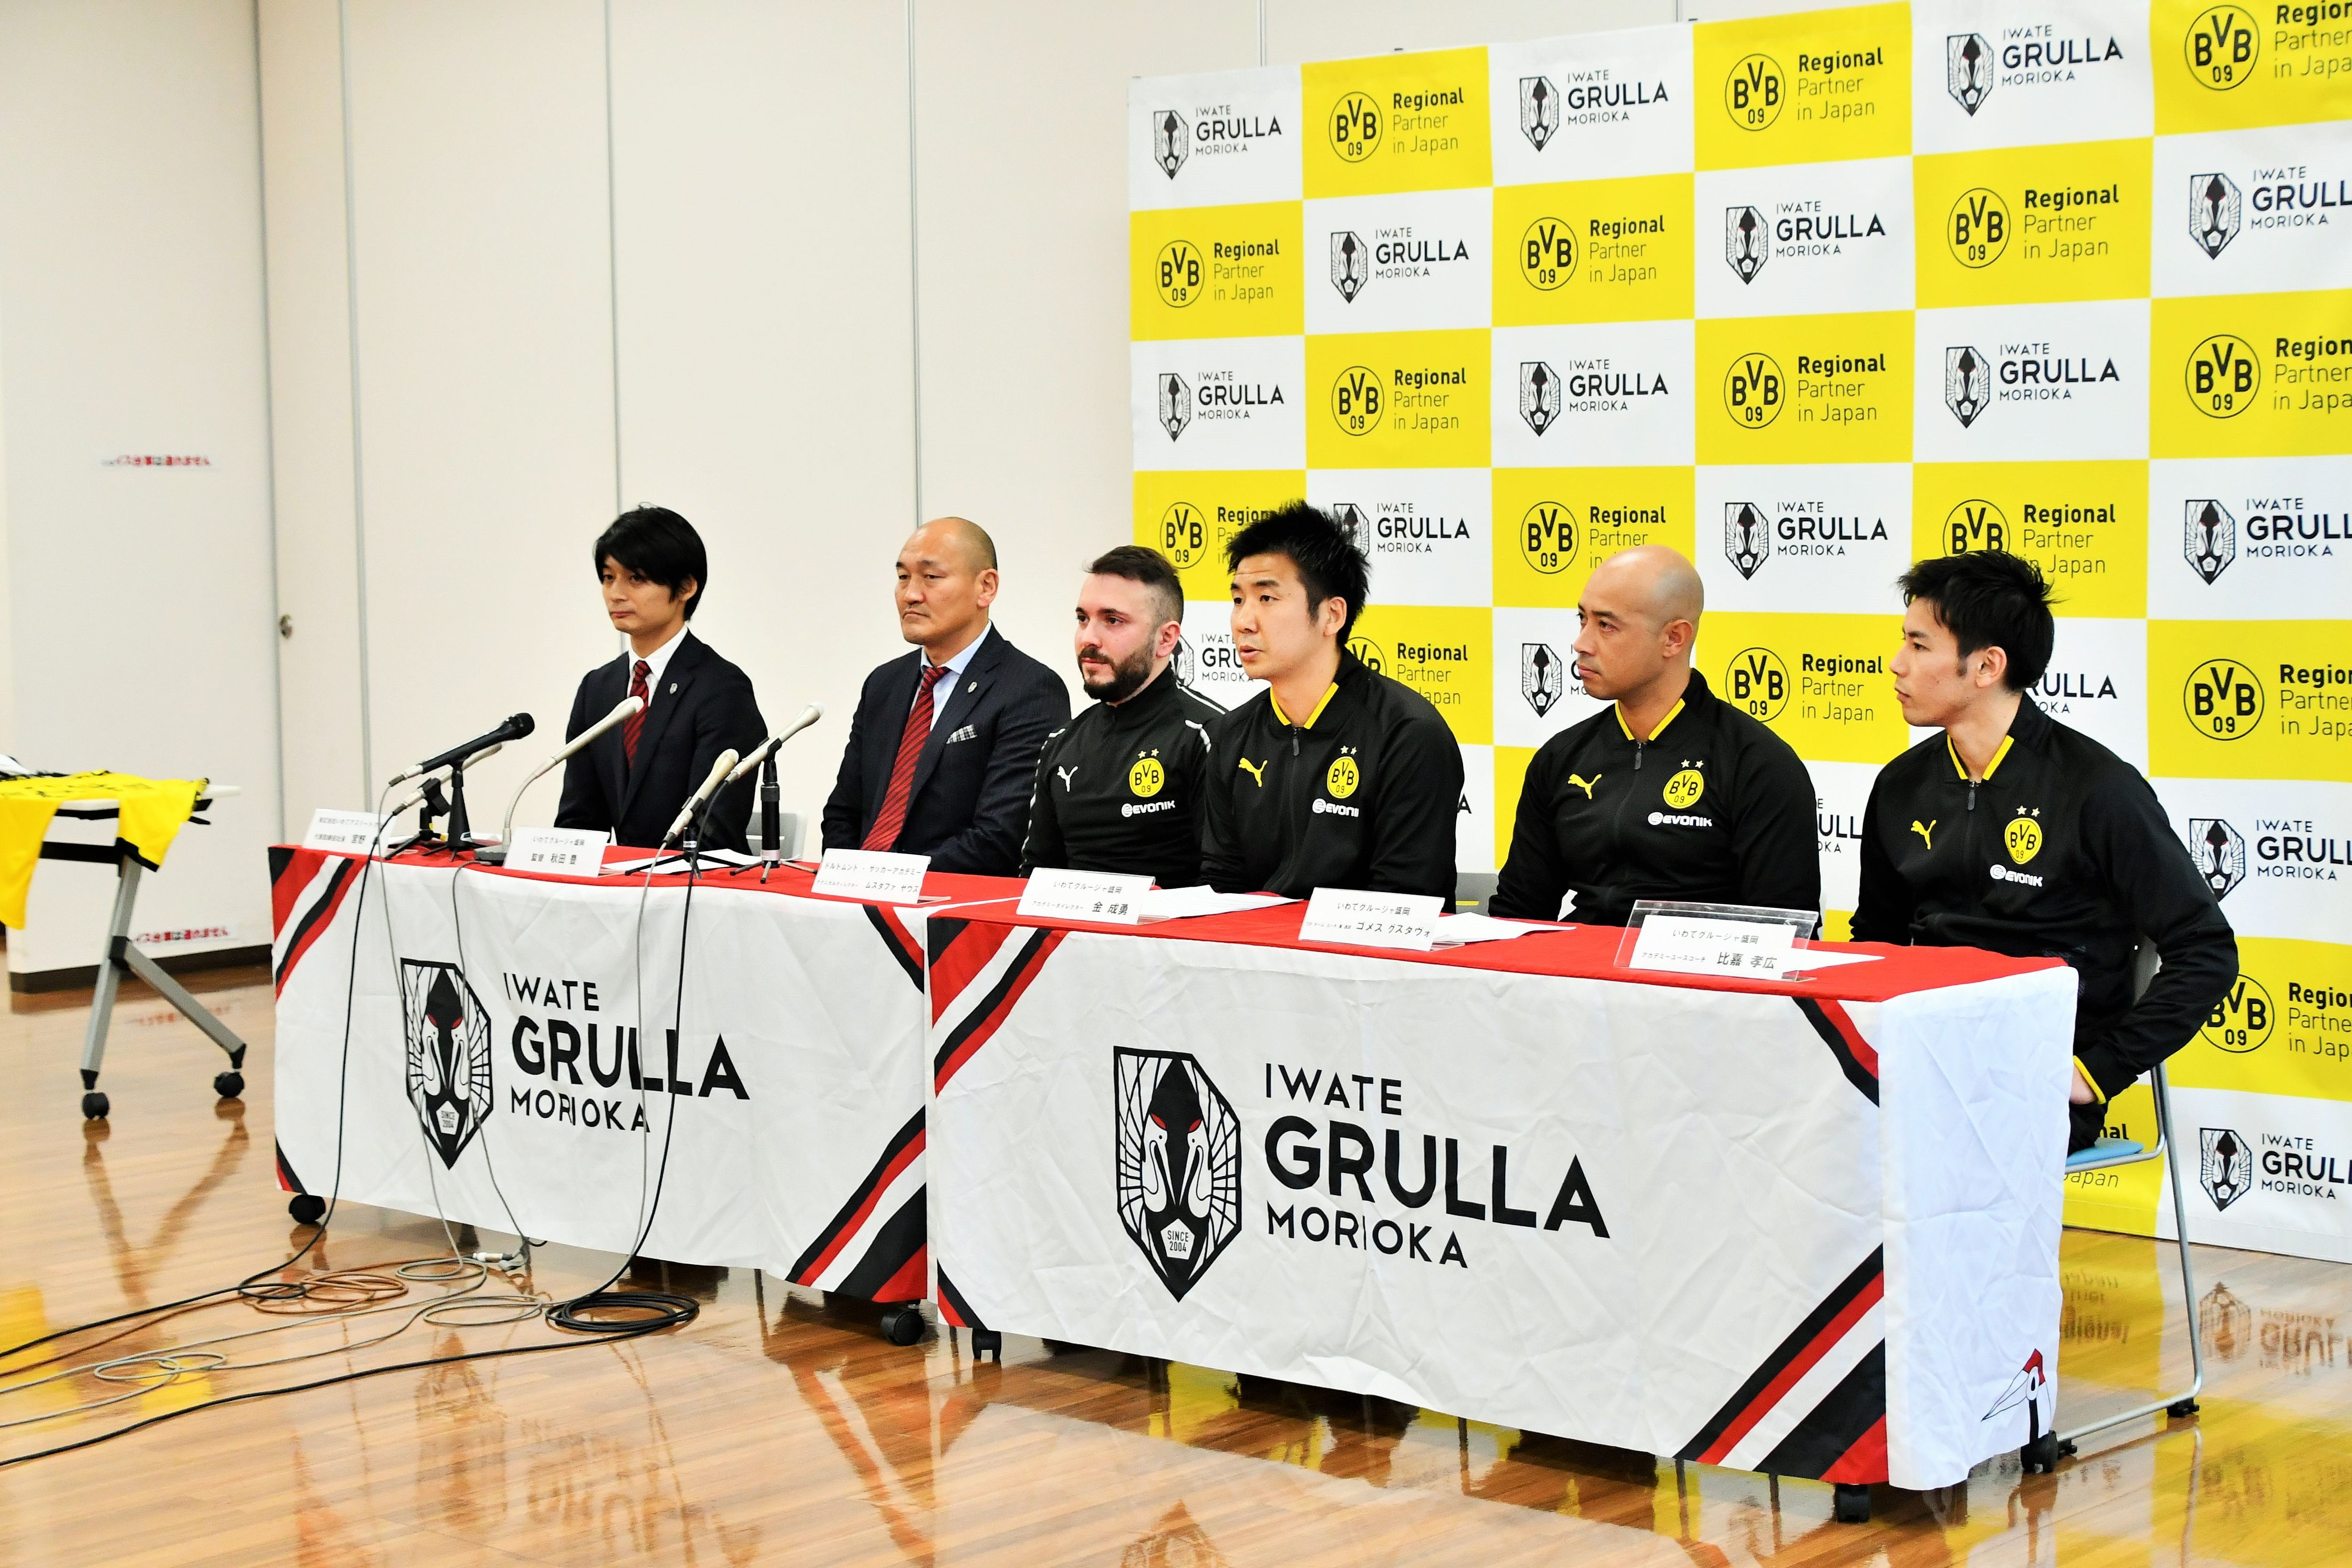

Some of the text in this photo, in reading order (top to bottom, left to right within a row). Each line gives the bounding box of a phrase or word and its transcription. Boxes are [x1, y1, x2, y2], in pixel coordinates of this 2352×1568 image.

[2003, 24, 2052, 40] IWATE
[2195, 12, 2252, 67] BVB
[1799, 47, 1884, 75] Regional
[2002, 35, 2124, 70] GRULLA
[1568, 69, 1609, 83] IWATE
[2212, 64, 2233, 83] 09
[2274, 58, 2291, 78] in
[1734, 61, 1779, 110] BVB
[1798, 78, 1864, 96] Partner
[2002, 70, 2075, 86] MORIOKA
[1393, 86, 1464, 112] Regional
[1568, 80, 1669, 110] GRULLA
[1196, 105, 1231, 117] IWATE
[1336, 98, 1377, 143] BVB
[1568, 110, 1630, 125] MORIOKA
[1748, 108, 1764, 124] 09
[1797, 101, 1874, 123] in Japan
[1196, 115, 1282, 142] GRULLA
[1393, 114, 1448, 132] Partner
[1196, 143, 1247, 155] MORIOKA
[1348, 141, 1362, 156] 09
[1394, 135, 1458, 156] in Japan
[2253, 166, 2306, 182] IWATE
[1777, 201, 1821, 214] IWATE
[2025, 184, 2119, 212] Regional
[1590, 214, 1665, 239] Regional
[1776, 213, 1886, 242] GRULLA
[1955, 195, 2003, 245] BVB
[2024, 214, 2097, 234] Partner
[2251, 213, 2328, 229] MORIOKA
[1376, 227, 1411, 239] IWATE
[1214, 239, 1279, 261] Regional
[1376, 239, 1469, 264] GRULLA
[1528, 224, 1572, 269] BVB
[1590, 242, 1646, 259] Partner
[1776, 243, 1841, 258] MORIOKA
[1968, 244, 1986, 261] 09
[2024, 238, 2108, 262] in Japan
[1161, 246, 1200, 288] BVB
[1214, 263, 1264, 279] Partner
[1376, 267, 1430, 279] MORIOKA
[1539, 268, 1556, 284] 09
[1590, 264, 1656, 286] in Japan
[1172, 287, 1186, 301] 09
[1215, 284, 1273, 304] in Japan
[2000, 343, 2049, 356] IWATE
[1570, 359, 1609, 371] IWATE
[1798, 353, 1886, 378] Regional
[1999, 357, 2120, 384] GRULLA
[2195, 343, 2253, 394] BVB
[1199, 371, 1233, 382] IWATE
[1395, 367, 1466, 389] Regional
[1569, 372, 1669, 397] GRULLA
[1732, 360, 1779, 406] BVB
[1198, 384, 1285, 406] GRULLA
[1339, 372, 1379, 415] BVB
[1798, 380, 1865, 398] Partner
[1999, 388, 2072, 401] MORIOKA
[1395, 391, 1449, 408] Partner
[1569, 400, 1628, 412] MORIOKA
[2212, 393, 2233, 411] 09
[2274, 391, 2290, 410] in
[1198, 409, 1250, 420] MORIOKA
[1350, 415, 1364, 429] 09
[1394, 413, 1458, 434] in Japan
[1746, 406, 1763, 422] 09
[1798, 403, 1876, 426] in Japan
[1377, 503, 1413, 513] IWATE
[1778, 502, 1824, 513] IWATE
[2247, 498, 2304, 510] IWATE
[1590, 506, 1666, 527] Regional
[2024, 503, 2116, 528] Regional
[1166, 509, 1202, 549] BVB
[1377, 517, 1470, 539] GRULLA
[1528, 509, 1573, 552] BVB
[1590, 529, 1648, 546] Partner
[1778, 517, 1888, 540] GRULLA
[1952, 508, 2003, 554] BVB
[1377, 542, 1432, 553] MORIOKA
[2024, 529, 2094, 548] Partner
[1175, 549, 1189, 563] 09
[1541, 552, 1557, 567] 09
[1778, 544, 1845, 556] MORIOKA
[2246, 544, 2333, 557] MORIOKA
[2047, 554, 2105, 579] Japan
[1397, 643, 1468, 664] Regional
[1397, 664, 1451, 682] Partner
[1802, 653, 1883, 676] Regional
[1734, 655, 1783, 700] BVB
[1803, 677, 1864, 697] Partner
[2194, 667, 2256, 716] BVB
[1749, 700, 1767, 715] 09
[1803, 700, 1874, 725] in Japan
[2213, 716, 2236, 733] 09
[2281, 715, 2299, 735] in
[1135, 764, 1159, 785] BVB
[1331, 761, 1354, 785] BVB
[1669, 775, 1698, 796] BVB
[2257, 820, 2313, 832] IWATE
[2010, 824, 2036, 850] BVB
[2016, 850, 2023, 859] 09
[2257, 865, 2337, 881] MORIOKA
[1092, 902, 1103, 912] 金
[1107, 903, 1129, 915] 成勇
[1337, 902, 1411, 916] いわてグルージャ盛岡
[1356, 922, 1383, 933] ゴメス
[1388, 924, 1431, 938] グスタヴォ
[1673, 929, 1759, 944] いわてグルージャ盛岡
[1717, 951, 1744, 966] 比嘉
[1750, 955, 1778, 969] 孝広
[503, 972, 600, 1012] IWATE
[2225, 1029, 2247, 1046] 09
[512, 1015, 751, 1100] GRULLA
[1265, 1062, 1403, 1116] IWATE
[511, 1085, 651, 1133] MORIOKA
[2262, 1133, 2313, 1151] IWATE
[1264, 1115, 1611, 1239] GRULLA
[2261, 1178, 2336, 1200] MORIOKA
[1167, 1230, 1189, 1242] SINCE
[1266, 1200, 1469, 1269] MORIOKA
[1169, 1241, 1187, 1253] 2004
